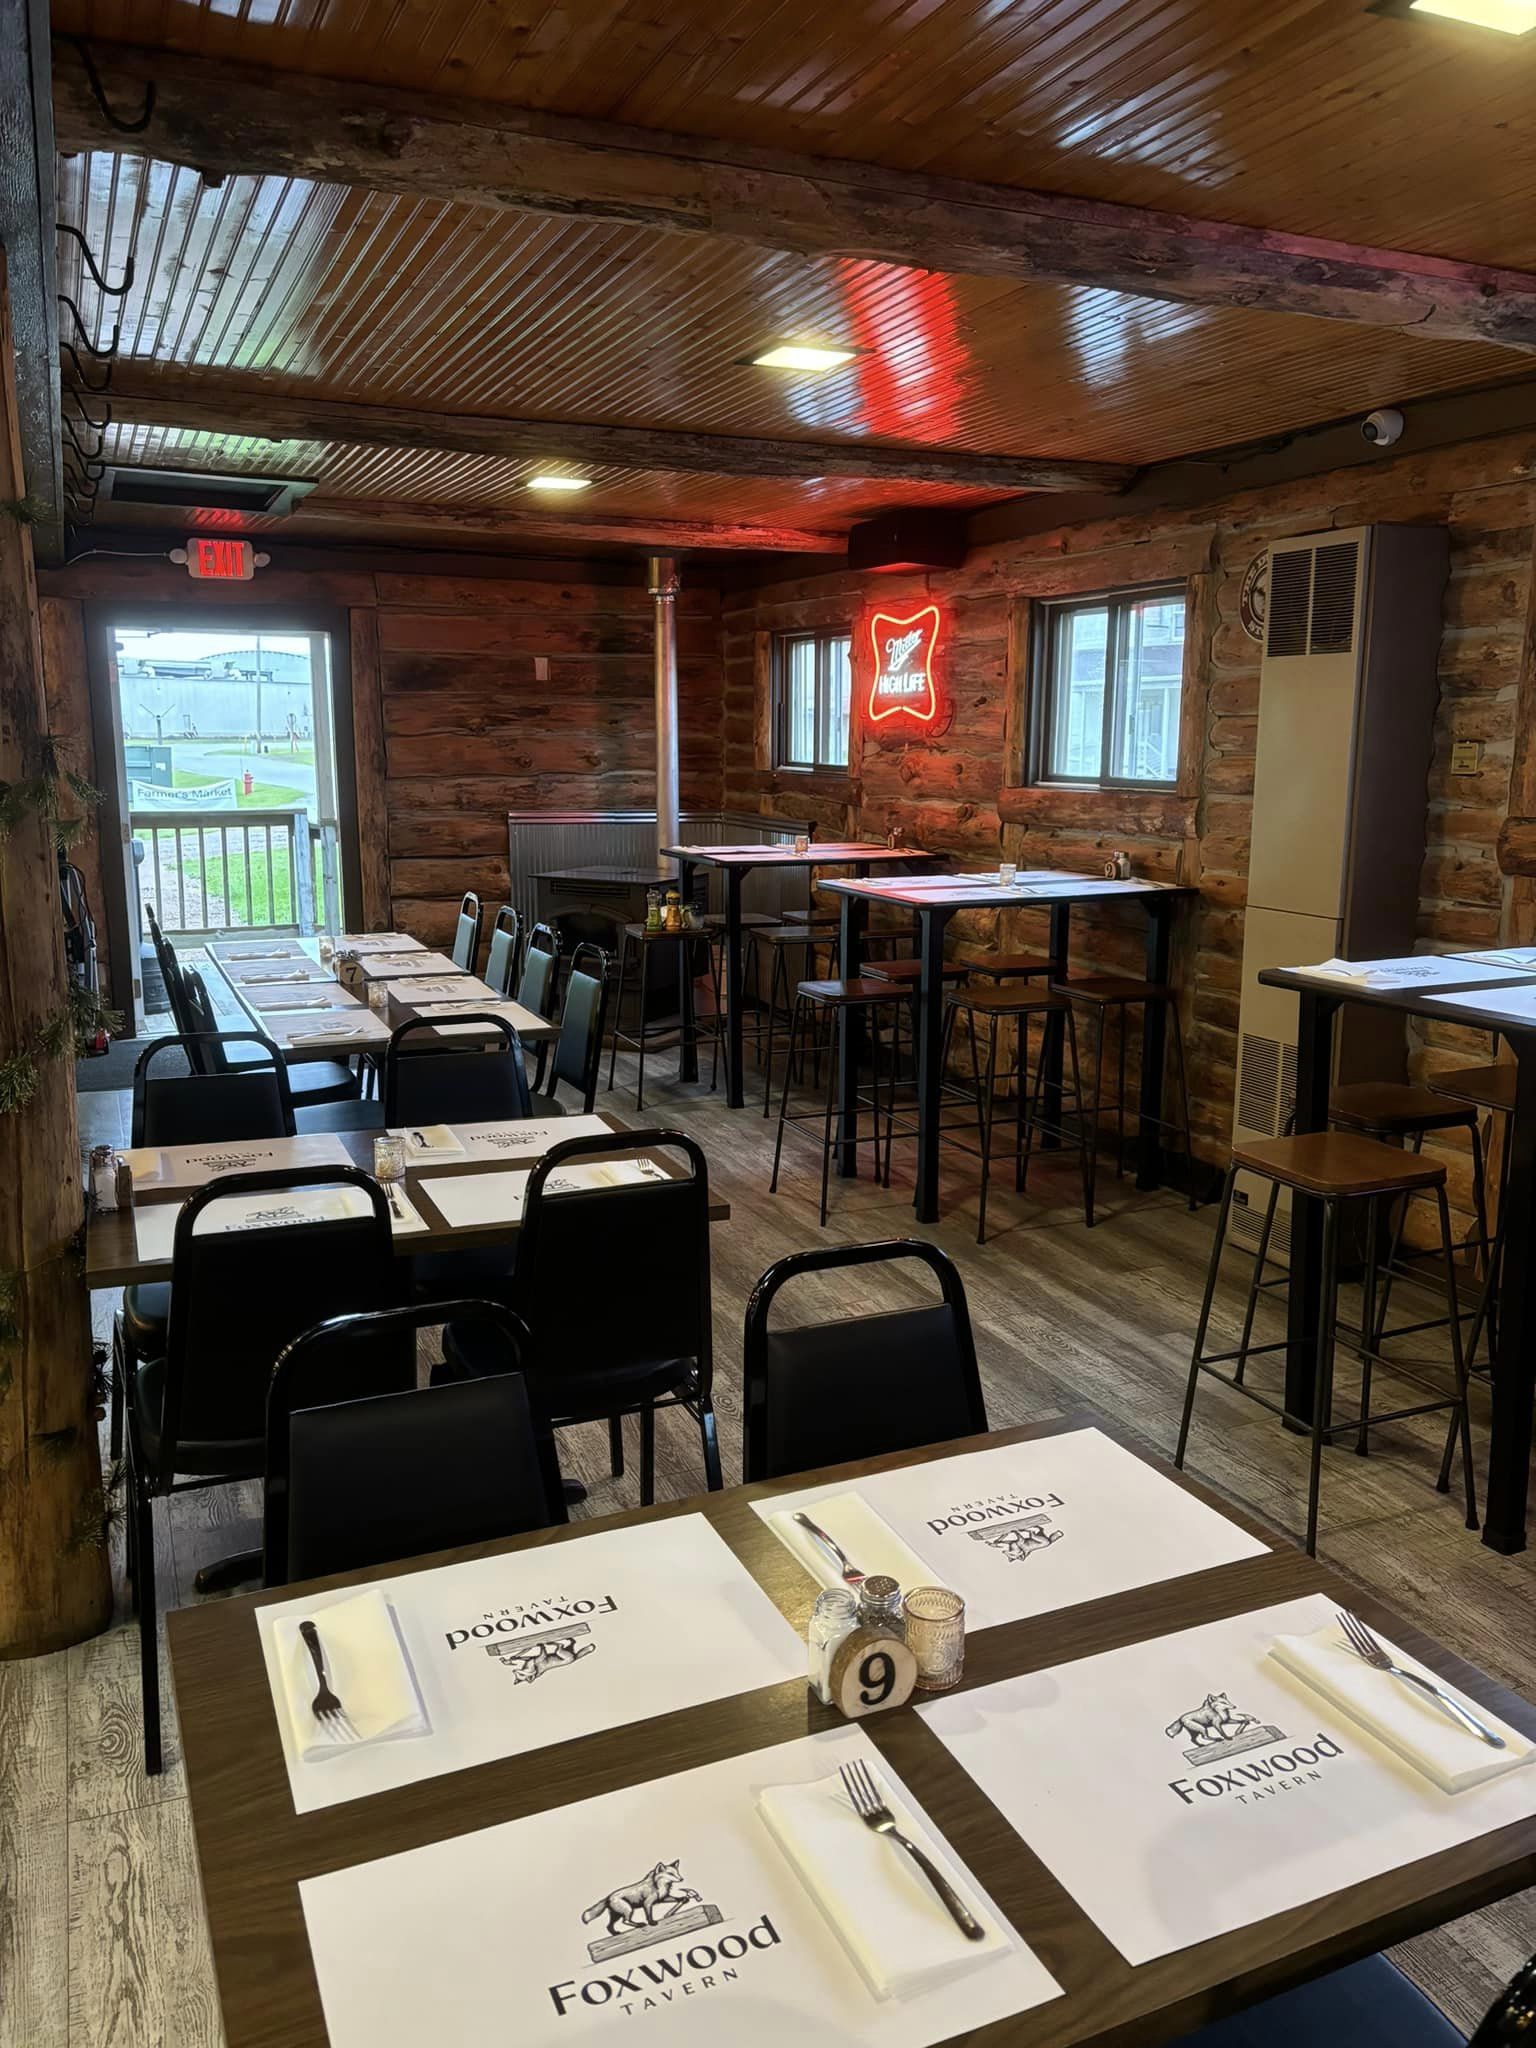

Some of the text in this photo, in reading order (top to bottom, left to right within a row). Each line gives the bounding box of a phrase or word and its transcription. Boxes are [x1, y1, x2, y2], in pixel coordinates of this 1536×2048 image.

[198, 540, 244, 577] EXIT
[885, 628, 923, 671] Miller
[878, 672, 926, 695] HIGH LIFE
[192, 787, 232, 799] Market
[345, 966, 357, 983] 7
[950, 1493, 1019, 1513] TAVERN
[482, 1595, 569, 1620] TAVERN
[858, 1651, 897, 1706] 9
[1235, 1770, 1323, 1805] TAVERN
[620, 1967, 739, 2016] TAVERN
